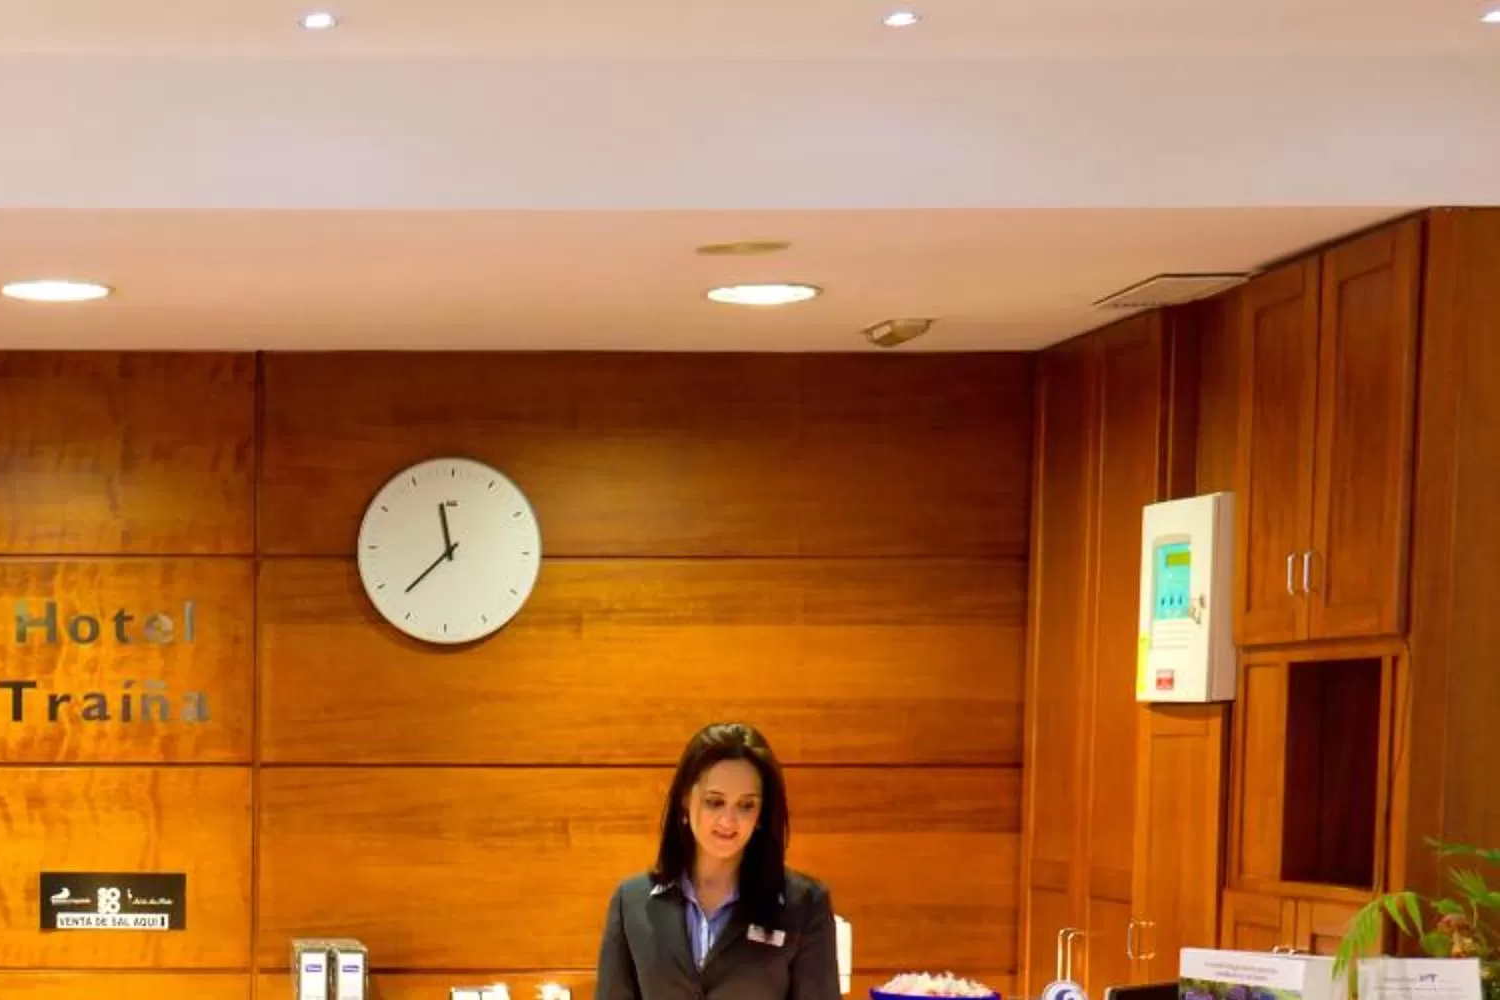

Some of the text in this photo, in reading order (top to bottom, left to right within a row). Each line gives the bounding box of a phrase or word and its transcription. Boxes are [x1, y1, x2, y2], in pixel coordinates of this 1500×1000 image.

[15, 600, 195, 644] Hotel
[59, 916, 92, 927] VENTA
[95, 916, 107, 927] DE
[112, 916, 130, 927] SAL
